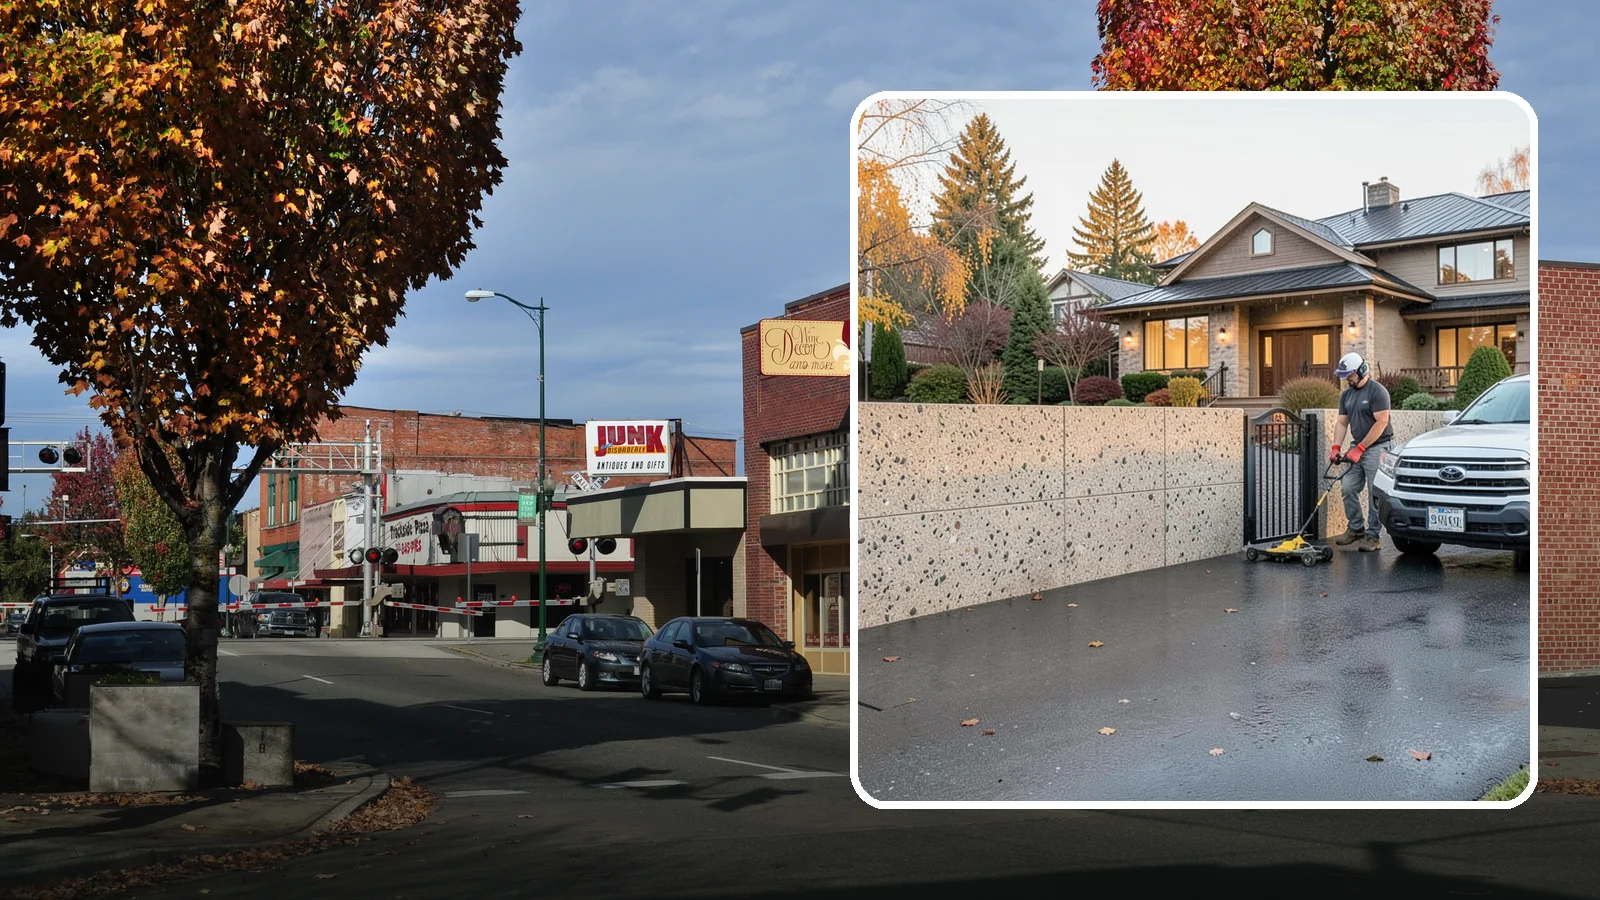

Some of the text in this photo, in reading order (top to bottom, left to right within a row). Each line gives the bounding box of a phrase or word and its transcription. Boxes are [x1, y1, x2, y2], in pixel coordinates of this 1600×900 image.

[595, 425, 665, 457] JUNK
[607, 446, 646, 454] DISORDERLY
[597, 460, 666, 470] ANTIQUES AND GIFTS
[573, 473, 589, 491] RAIL
[353, 497, 365, 511] CRO
[390, 519, 429, 540] Trackside Pizza
